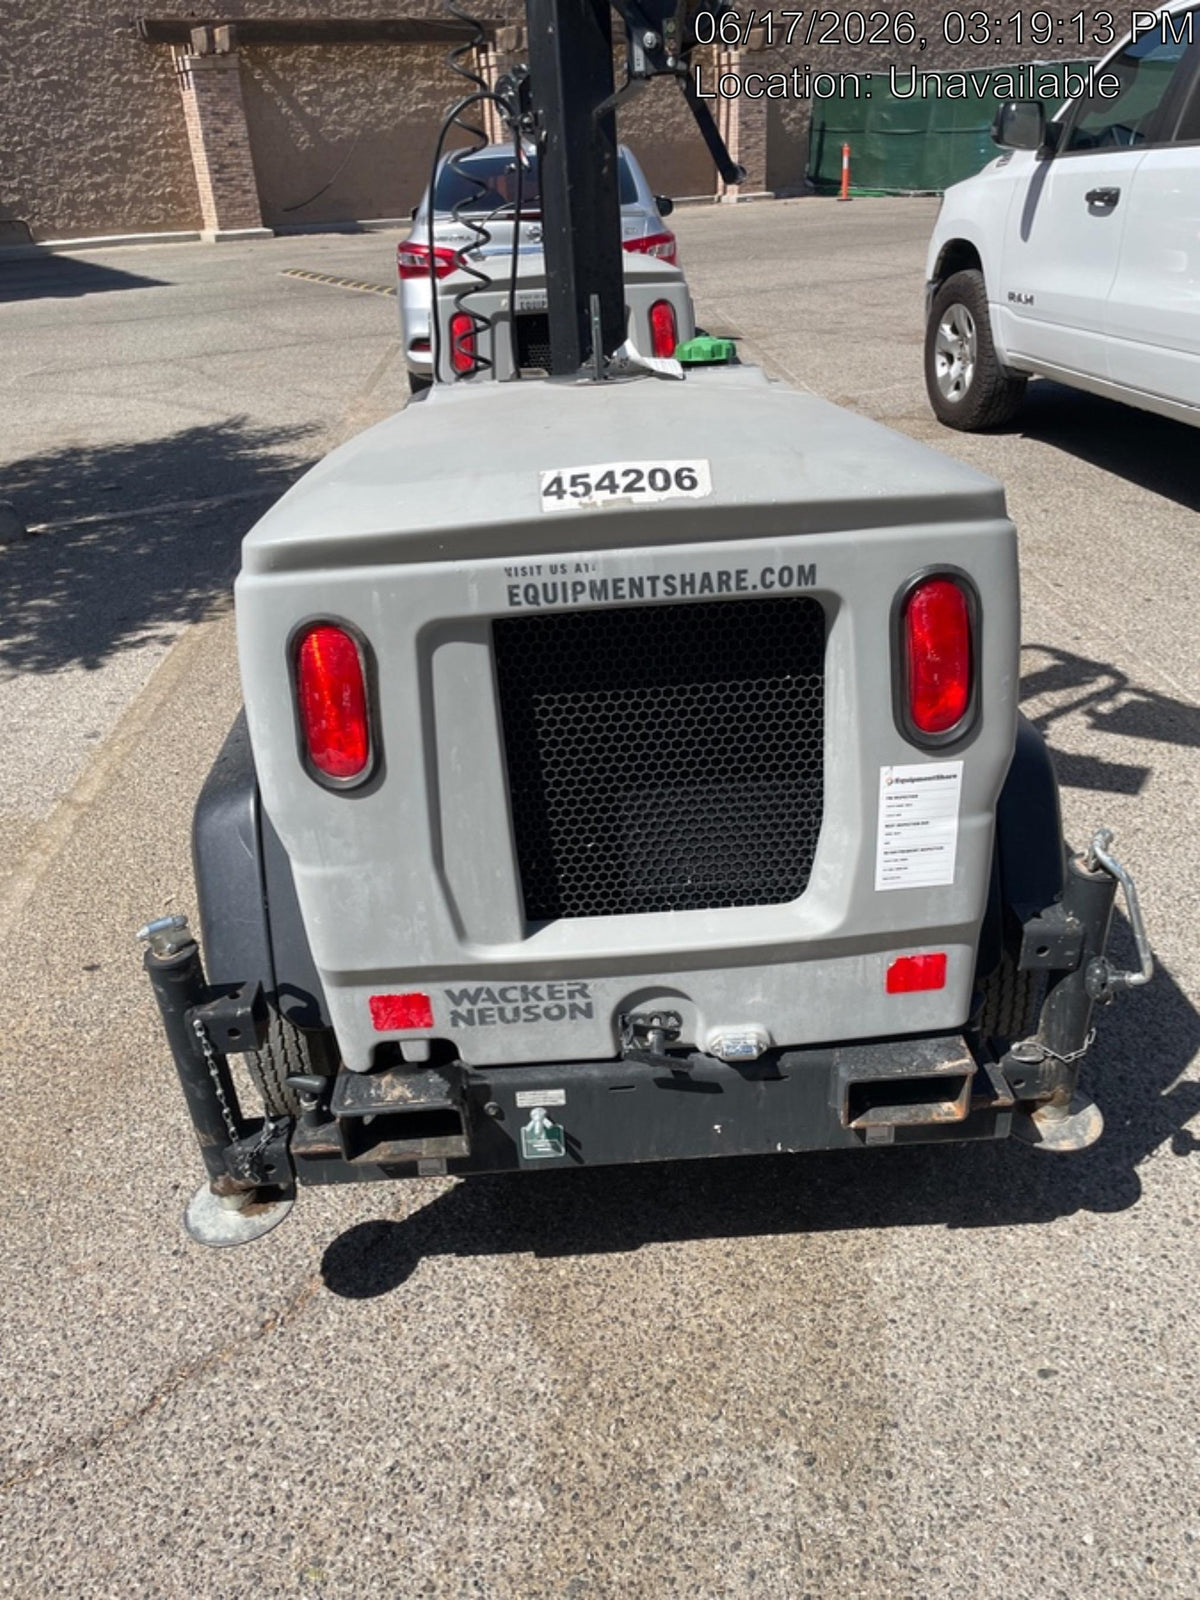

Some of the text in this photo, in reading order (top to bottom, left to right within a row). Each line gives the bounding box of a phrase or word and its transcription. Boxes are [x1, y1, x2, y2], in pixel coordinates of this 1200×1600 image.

[1008, 291, 1034, 306] RAM
[542, 467, 698, 500] 454206
[504, 565, 542, 577] VISIT
[549, 563, 568, 575] US
[507, 563, 817, 607] EQUIPMENTSHARE.COM
[444, 982, 592, 1006] WACKER
[450, 1002, 594, 1027] NEUSON
